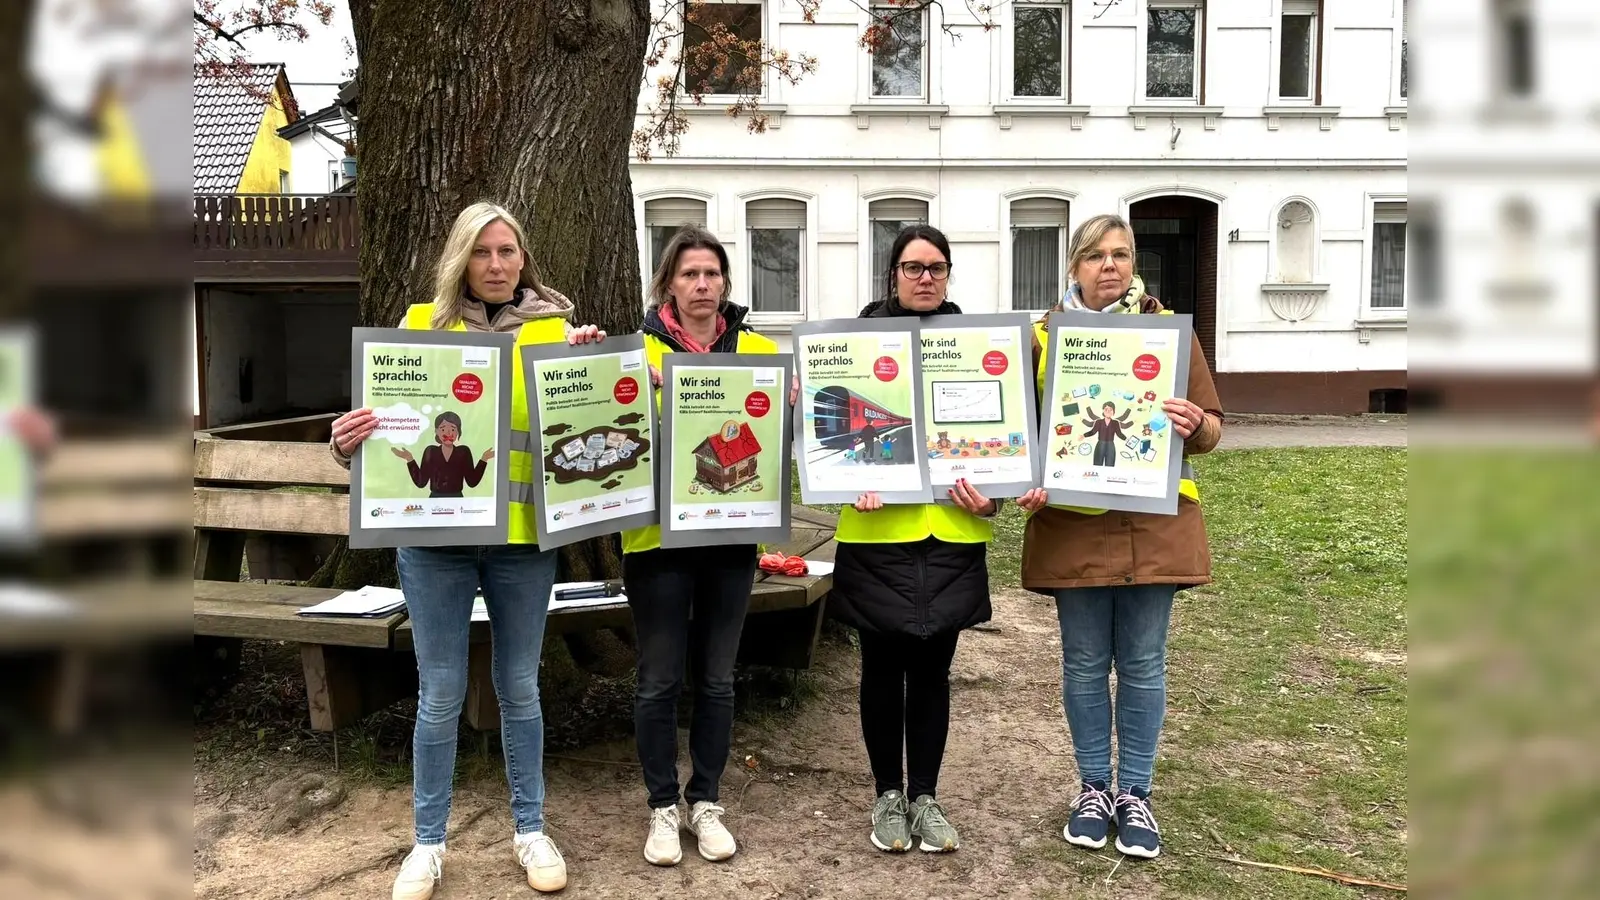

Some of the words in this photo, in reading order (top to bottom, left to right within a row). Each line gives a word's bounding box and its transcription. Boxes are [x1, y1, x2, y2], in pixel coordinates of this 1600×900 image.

[1228, 228, 1239, 242] 11
[808, 344, 825, 353] Wir
[828, 343, 847, 352] sind
[937, 338, 956, 347] sind
[1065, 338, 1083, 347] Wir
[1086, 339, 1107, 348] sind
[373, 355, 394, 366] Wir
[398, 356, 421, 366] sind
[922, 350, 961, 361] prachlos
[1064, 352, 1111, 362] sprachlos
[808, 356, 853, 368] sprachlos
[373, 370, 427, 383] sprachlos
[543, 370, 562, 381] Wir
[566, 367, 587, 378] sind
[680, 377, 698, 386] Wir
[700, 377, 720, 386] sind
[545, 382, 593, 397] sprachlos
[680, 390, 725, 401] sprachlos
